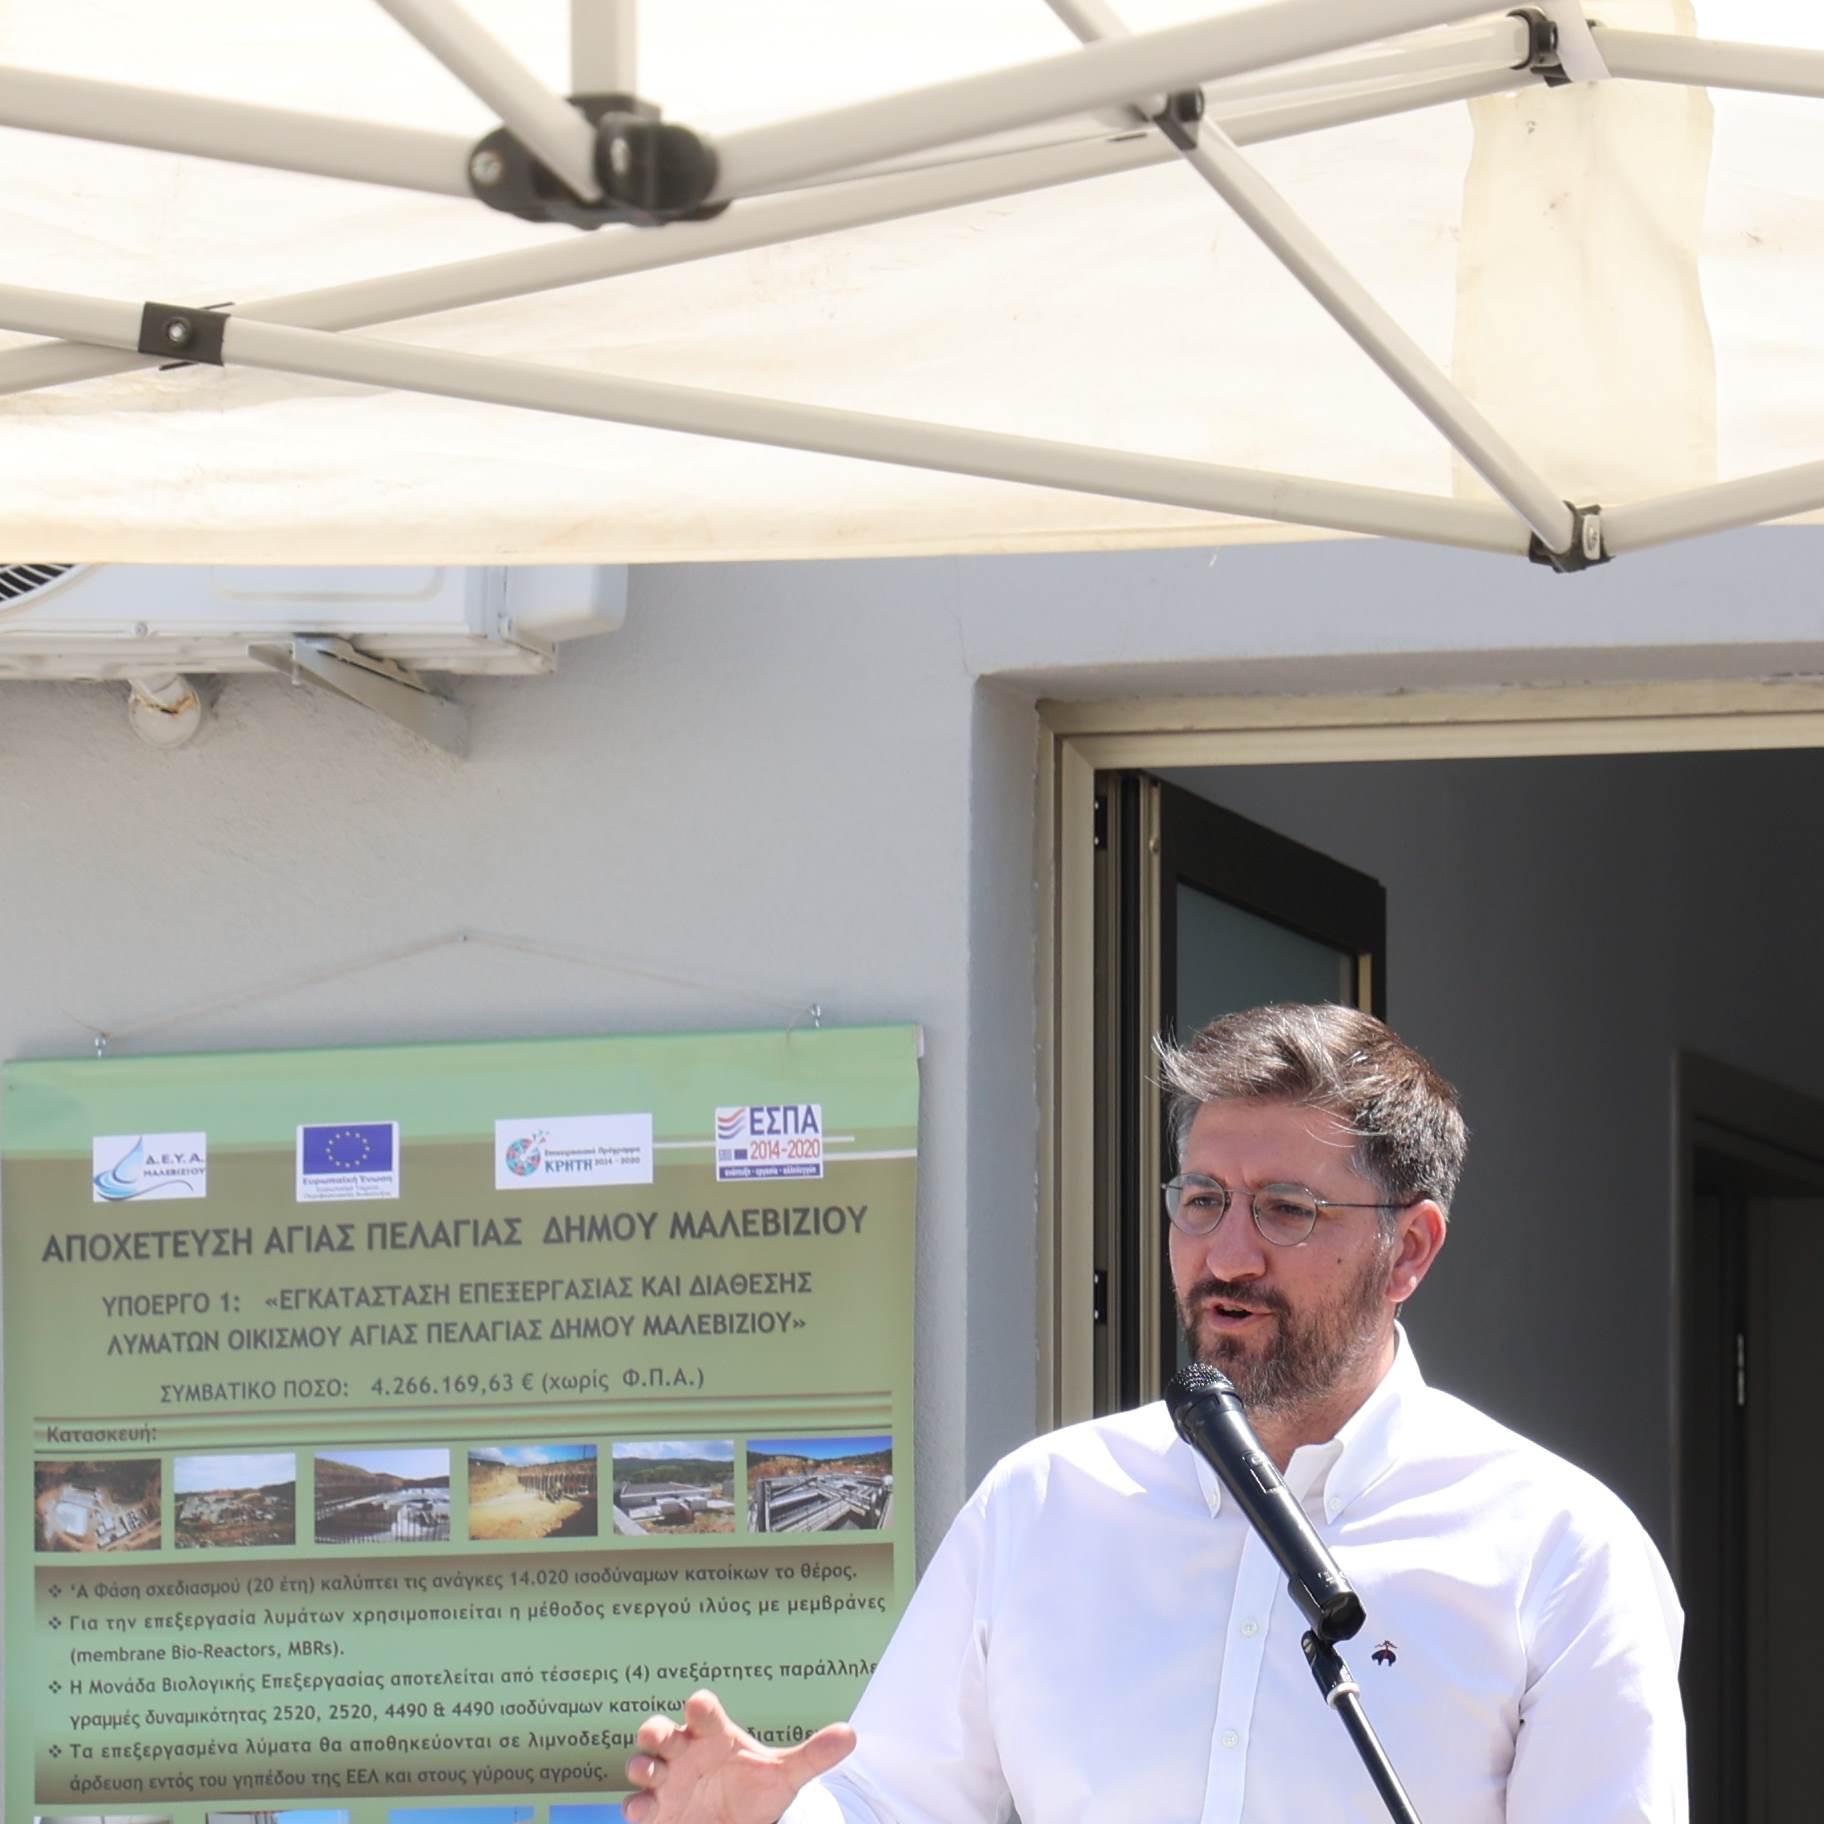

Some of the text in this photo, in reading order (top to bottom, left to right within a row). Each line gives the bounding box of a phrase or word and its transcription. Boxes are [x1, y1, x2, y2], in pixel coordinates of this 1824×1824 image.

[750, 1105, 819, 1135] ΕΣΠΑ
[545, 1159, 592, 1173] ΚΡΗΤΗ
[750, 1139, 820, 1160] 2014-2020
[42, 1205, 868, 1262] ΑΠΟΧΕΤΕΥΣΗ ΑΓΙΑΣ ΠΕΛΑΓΙΑΣ ΔΗΜΟΥ ΜΑΛΕΒΙΖΙΟΥ
[102, 1272, 812, 1317] ΥΠΟΕΡΓΟ 1: «ΕΓΚΑΤΑΣΤΑΣΗ ΕΠΕΞΕΡΓΑΣΙΑΣ ΚΑΙ ΔΙΑΘΕΣΗΣ
[108, 1312, 806, 1356] ΛΥΜΑΤΩΝ ΟΙΚΙΣΜΟΥ ΑΓΙΑΣ ΠΕΛΑΓΙΑΣ ΔΗΜΟΥ ΜΑΛΕΒΙΖΙΟΥ»
[160, 1368, 704, 1403] ΣΥΜΒΑΤΙΚΟ ΠΟΣΟ: 4.266.169,63 € (χωρίς Φ.Π.Α.)
[94, 1582, 140, 1600] Φάση
[146, 1578, 240, 1598] σχεδιασμού
[246, 1577, 274, 1596] (20
[280, 1576, 315, 1594] έτη)
[321, 1574, 398, 1590] καλύπτει
[404, 1577, 427, 1592] τις
[432, 1571, 503, 1591] ανάγκες
[511, 1569, 568, 1586] 14.020
[575, 1566, 678, 1586] ισοδύναμων
[686, 1564, 768, 1581] κατοίκων
[775, 1568, 794, 1579] το
[800, 1562, 856, 1582] θέρος.
[70, 1640, 344, 1665] (membrane Bio-Reactors, MBRs).
